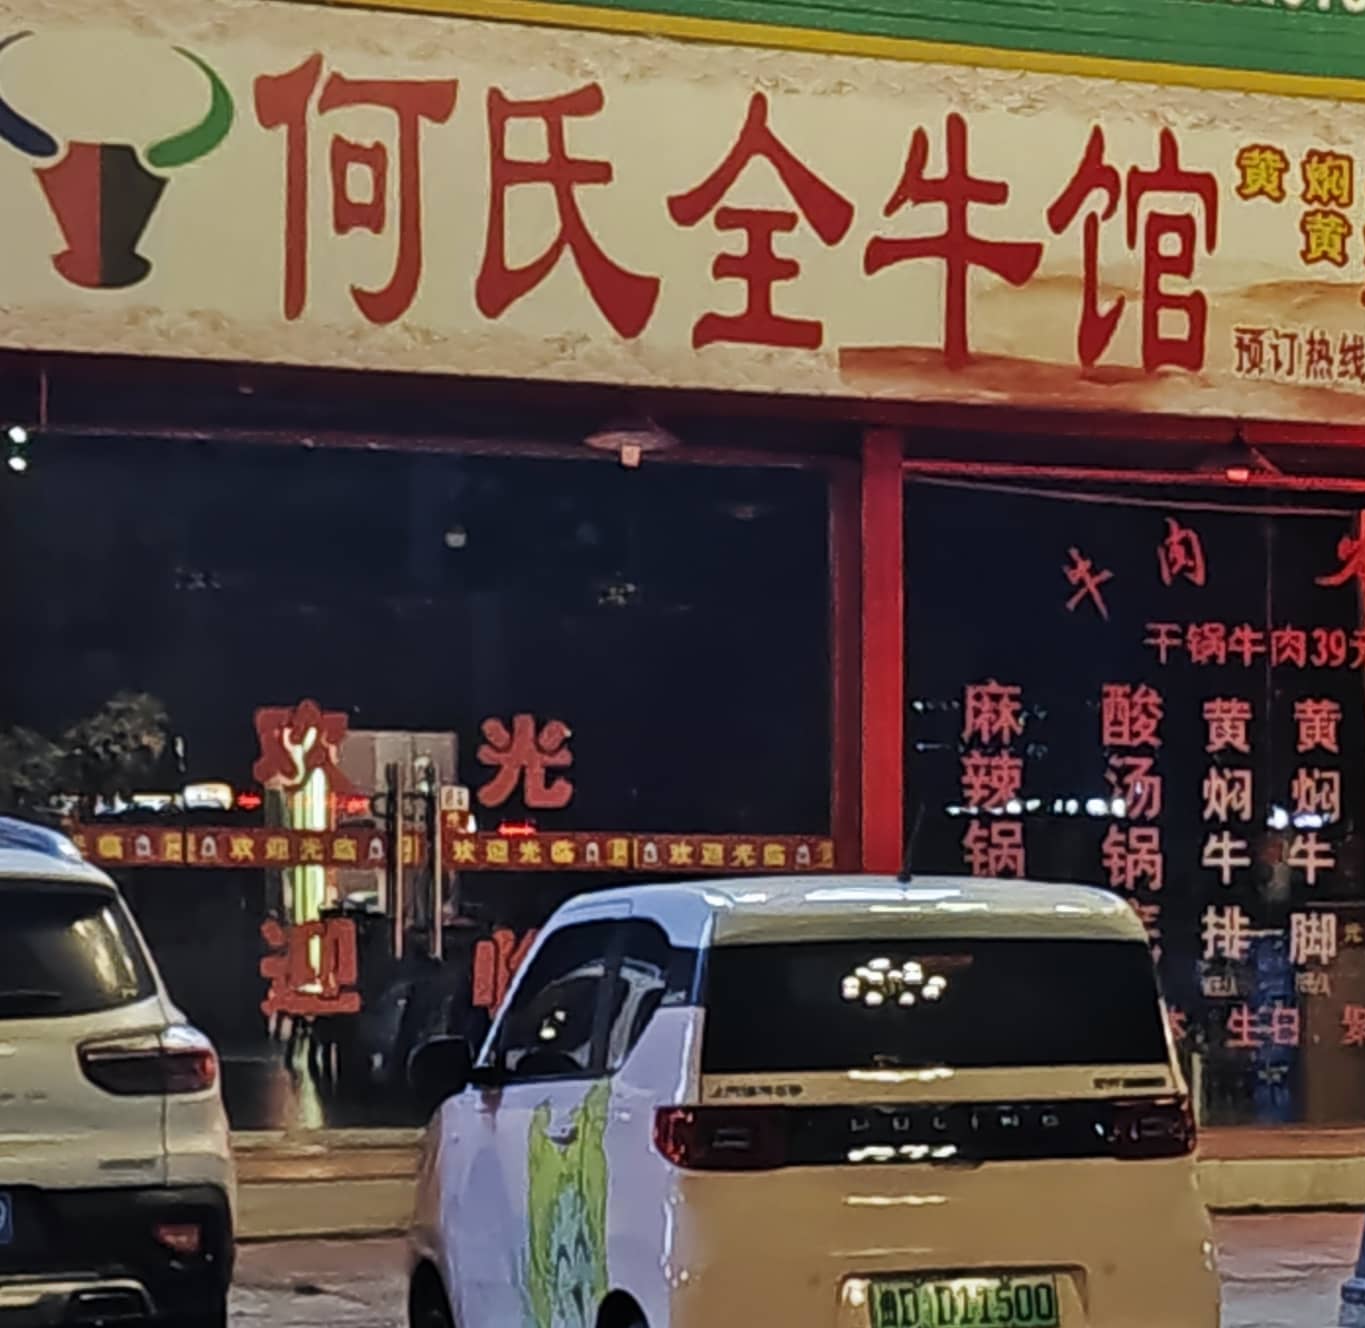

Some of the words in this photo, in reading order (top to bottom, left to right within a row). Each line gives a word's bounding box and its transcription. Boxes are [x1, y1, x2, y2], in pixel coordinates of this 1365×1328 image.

[253, 51, 1220, 372] 何氏全牛馆
[451, 838, 576, 864] 欢迎光临
[667, 840, 786, 868] 欢迎光临
[962, 678, 1027, 878] 麻辣锅
[1202, 698, 1252, 961] 黄焖牛排
[1289, 698, 1343, 965] 黄焖牛脚
